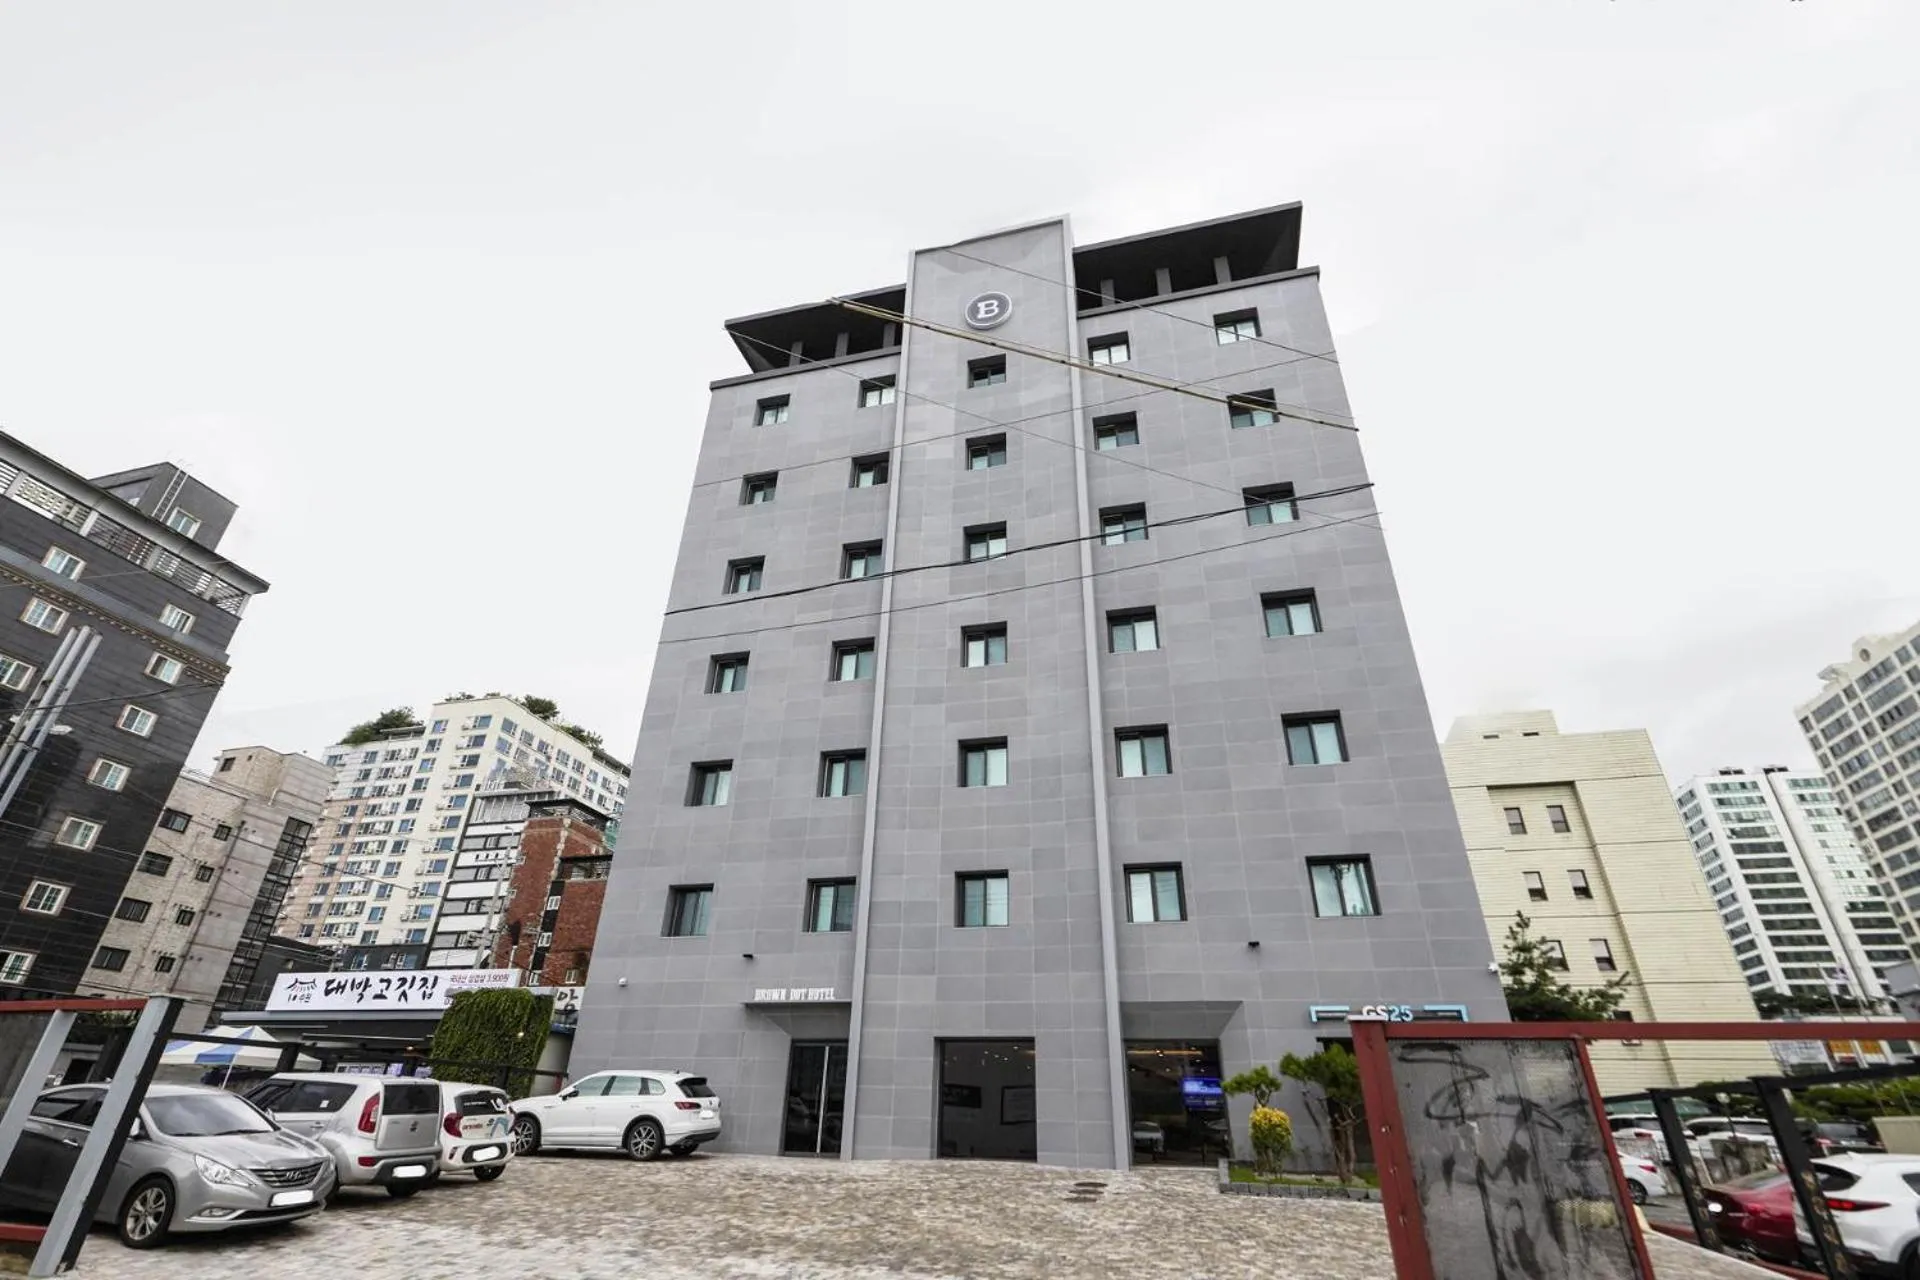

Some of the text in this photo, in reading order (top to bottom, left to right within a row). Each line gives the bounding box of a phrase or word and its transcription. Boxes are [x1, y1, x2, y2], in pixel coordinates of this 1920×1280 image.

[977, 299, 999, 319] B
[323, 975, 439, 1004] 대박고깃집
[754, 987, 835, 1001] BROWN DOT HOTEL
[1362, 1004, 1413, 1022] GS25
